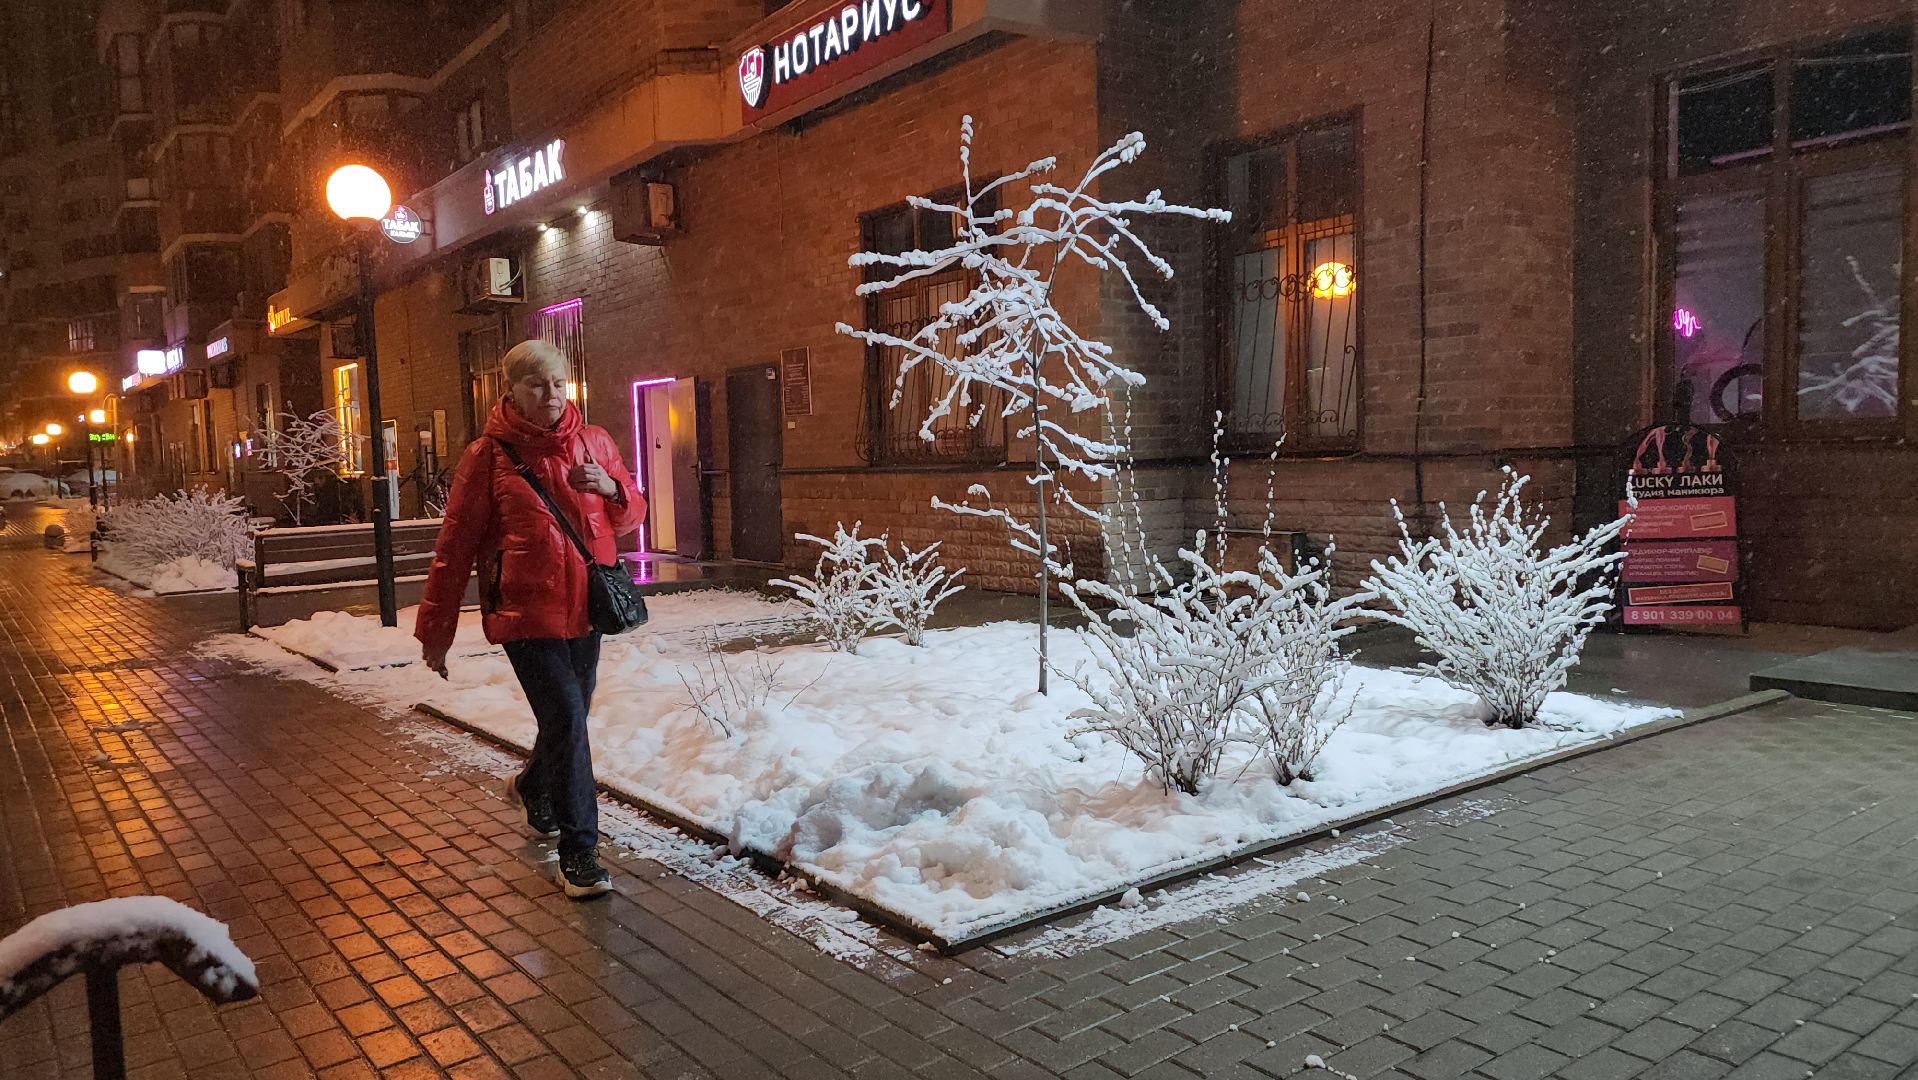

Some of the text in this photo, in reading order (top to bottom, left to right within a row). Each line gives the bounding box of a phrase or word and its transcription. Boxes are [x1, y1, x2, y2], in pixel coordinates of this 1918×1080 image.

[493, 138, 564, 209] ТАБАК
[382, 218, 420, 233] ТАБАК
[1679, 474, 1723, 488] ЛАКИ
[1630, 487, 1725, 498] тудия маникюра
[1626, 503, 1712, 513] МНИКЮР-КОМПЛЕКС
[1631, 610, 1734, 620] 8 901 339 00 04
